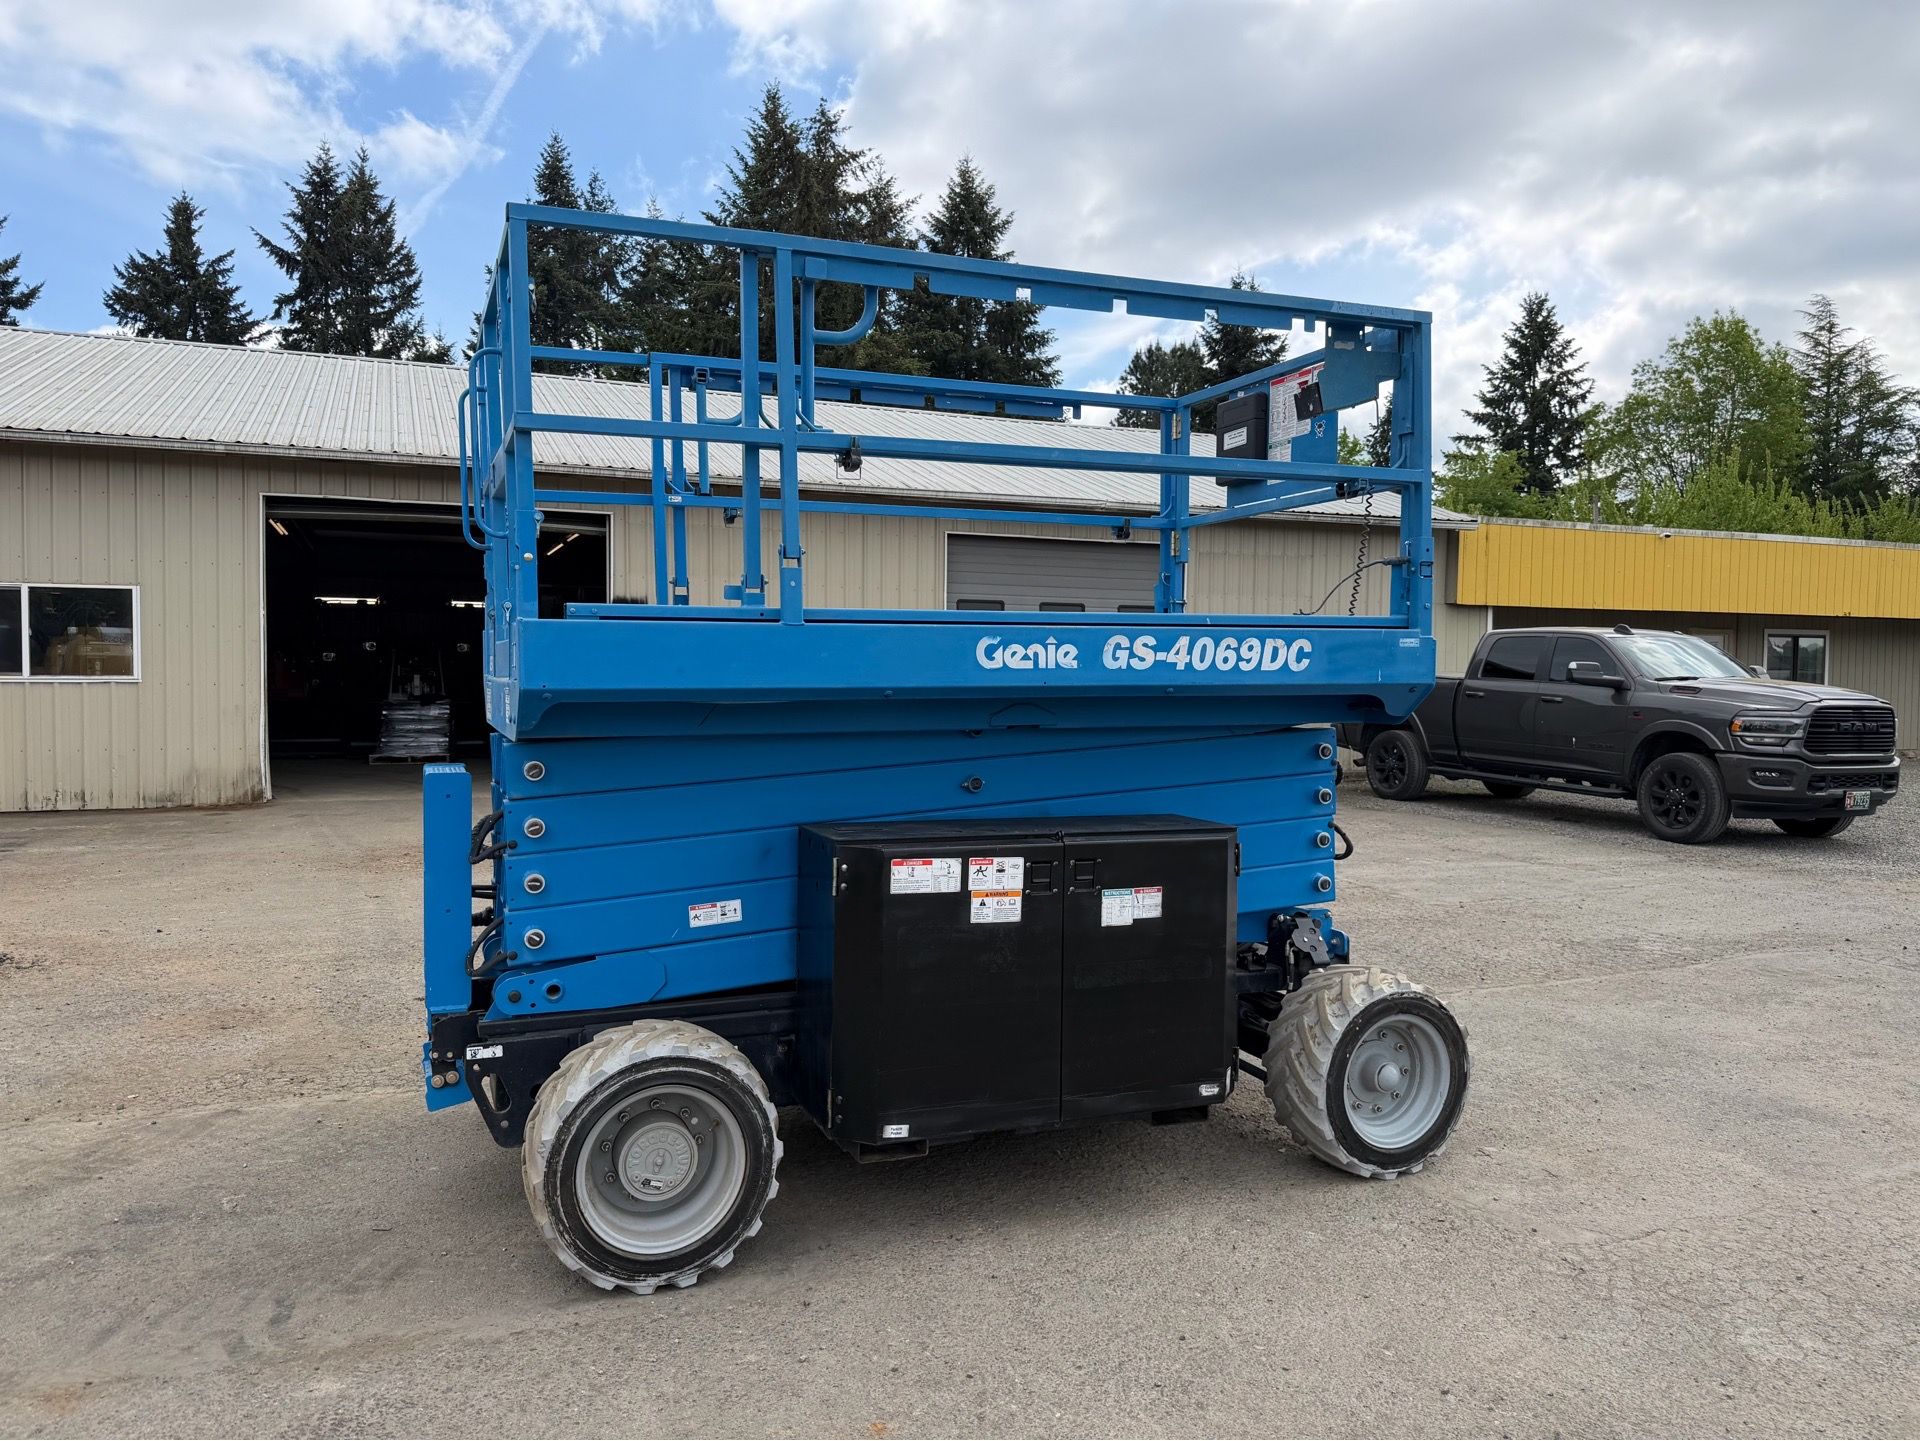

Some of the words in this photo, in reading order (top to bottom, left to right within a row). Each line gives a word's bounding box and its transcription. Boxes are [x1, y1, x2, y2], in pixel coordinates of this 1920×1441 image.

[975, 635, 1079, 670] Genie
[1102, 634, 1312, 673] GS-4069DC
[1839, 721, 1878, 732] RAM
